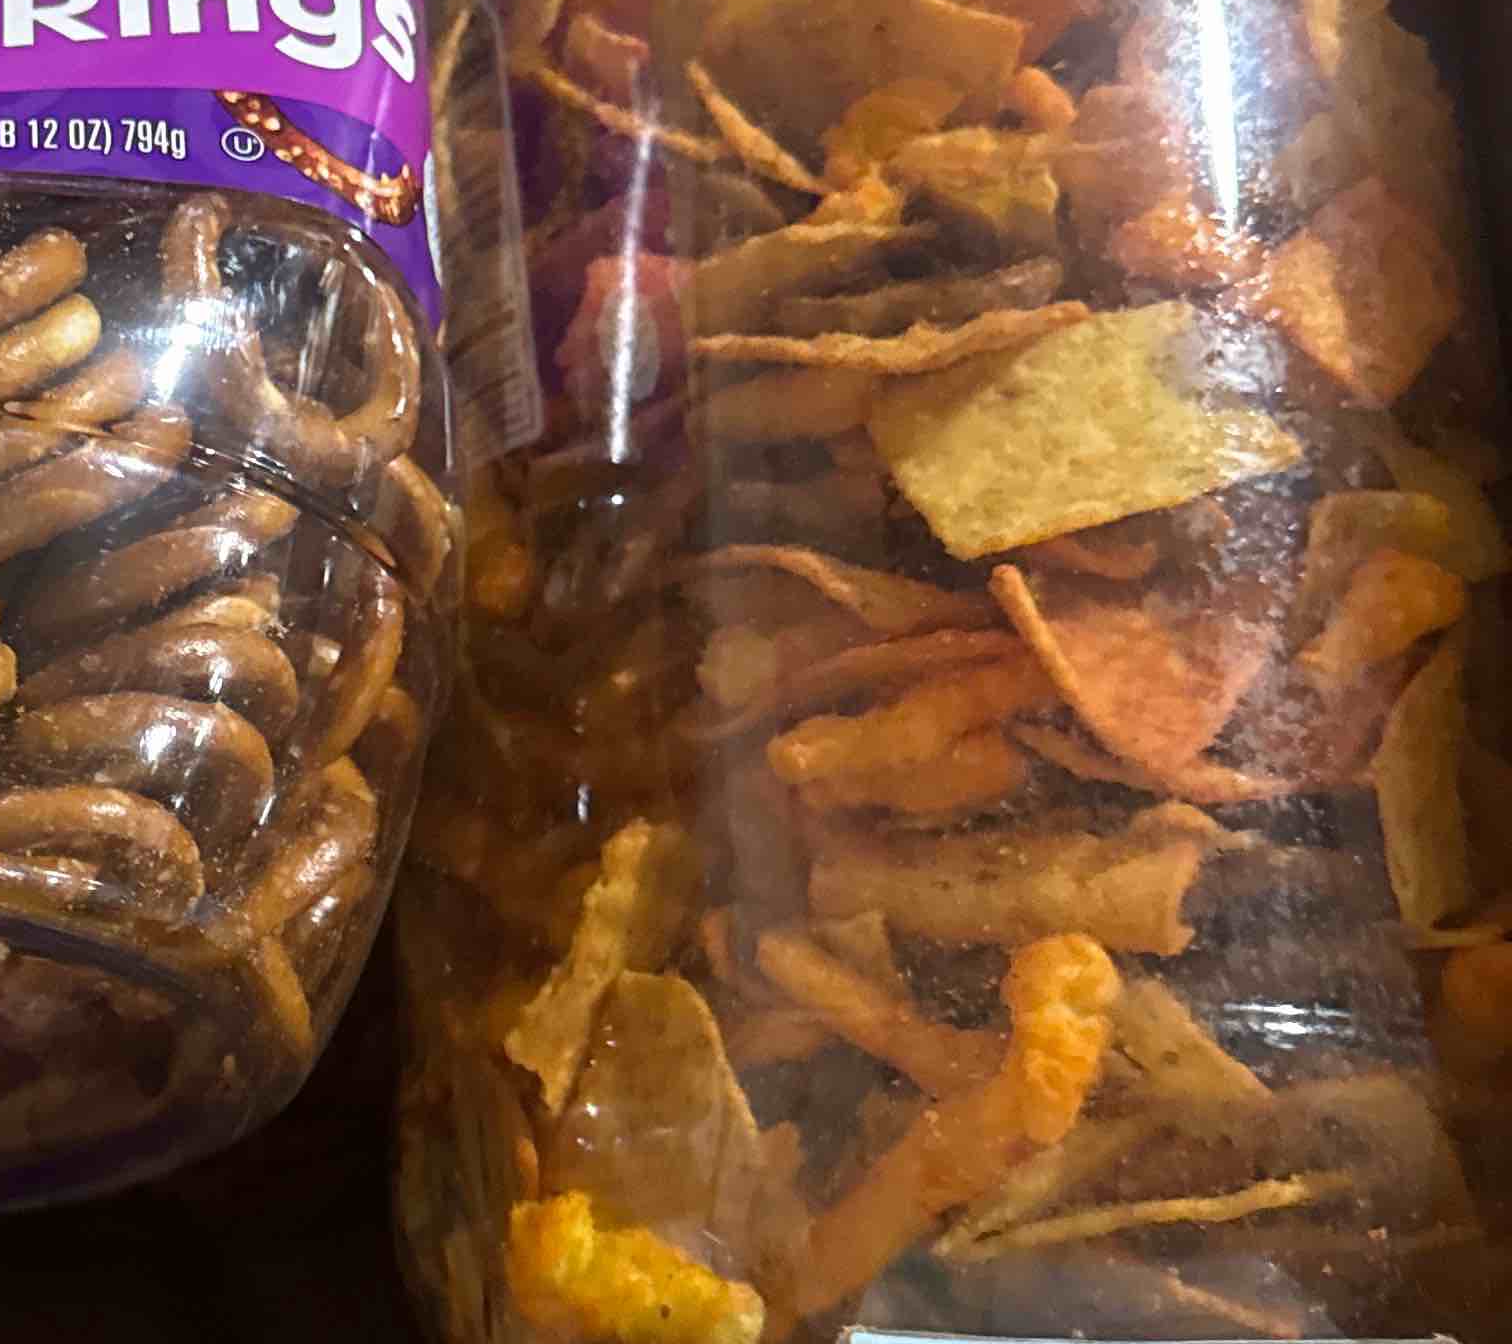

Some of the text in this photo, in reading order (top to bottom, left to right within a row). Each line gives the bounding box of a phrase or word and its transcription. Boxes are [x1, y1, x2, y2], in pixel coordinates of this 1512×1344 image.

[28, 120, 58, 148] 12
[69, 119, 112, 153] OZ)
[121, 120, 186, 158] 794g
